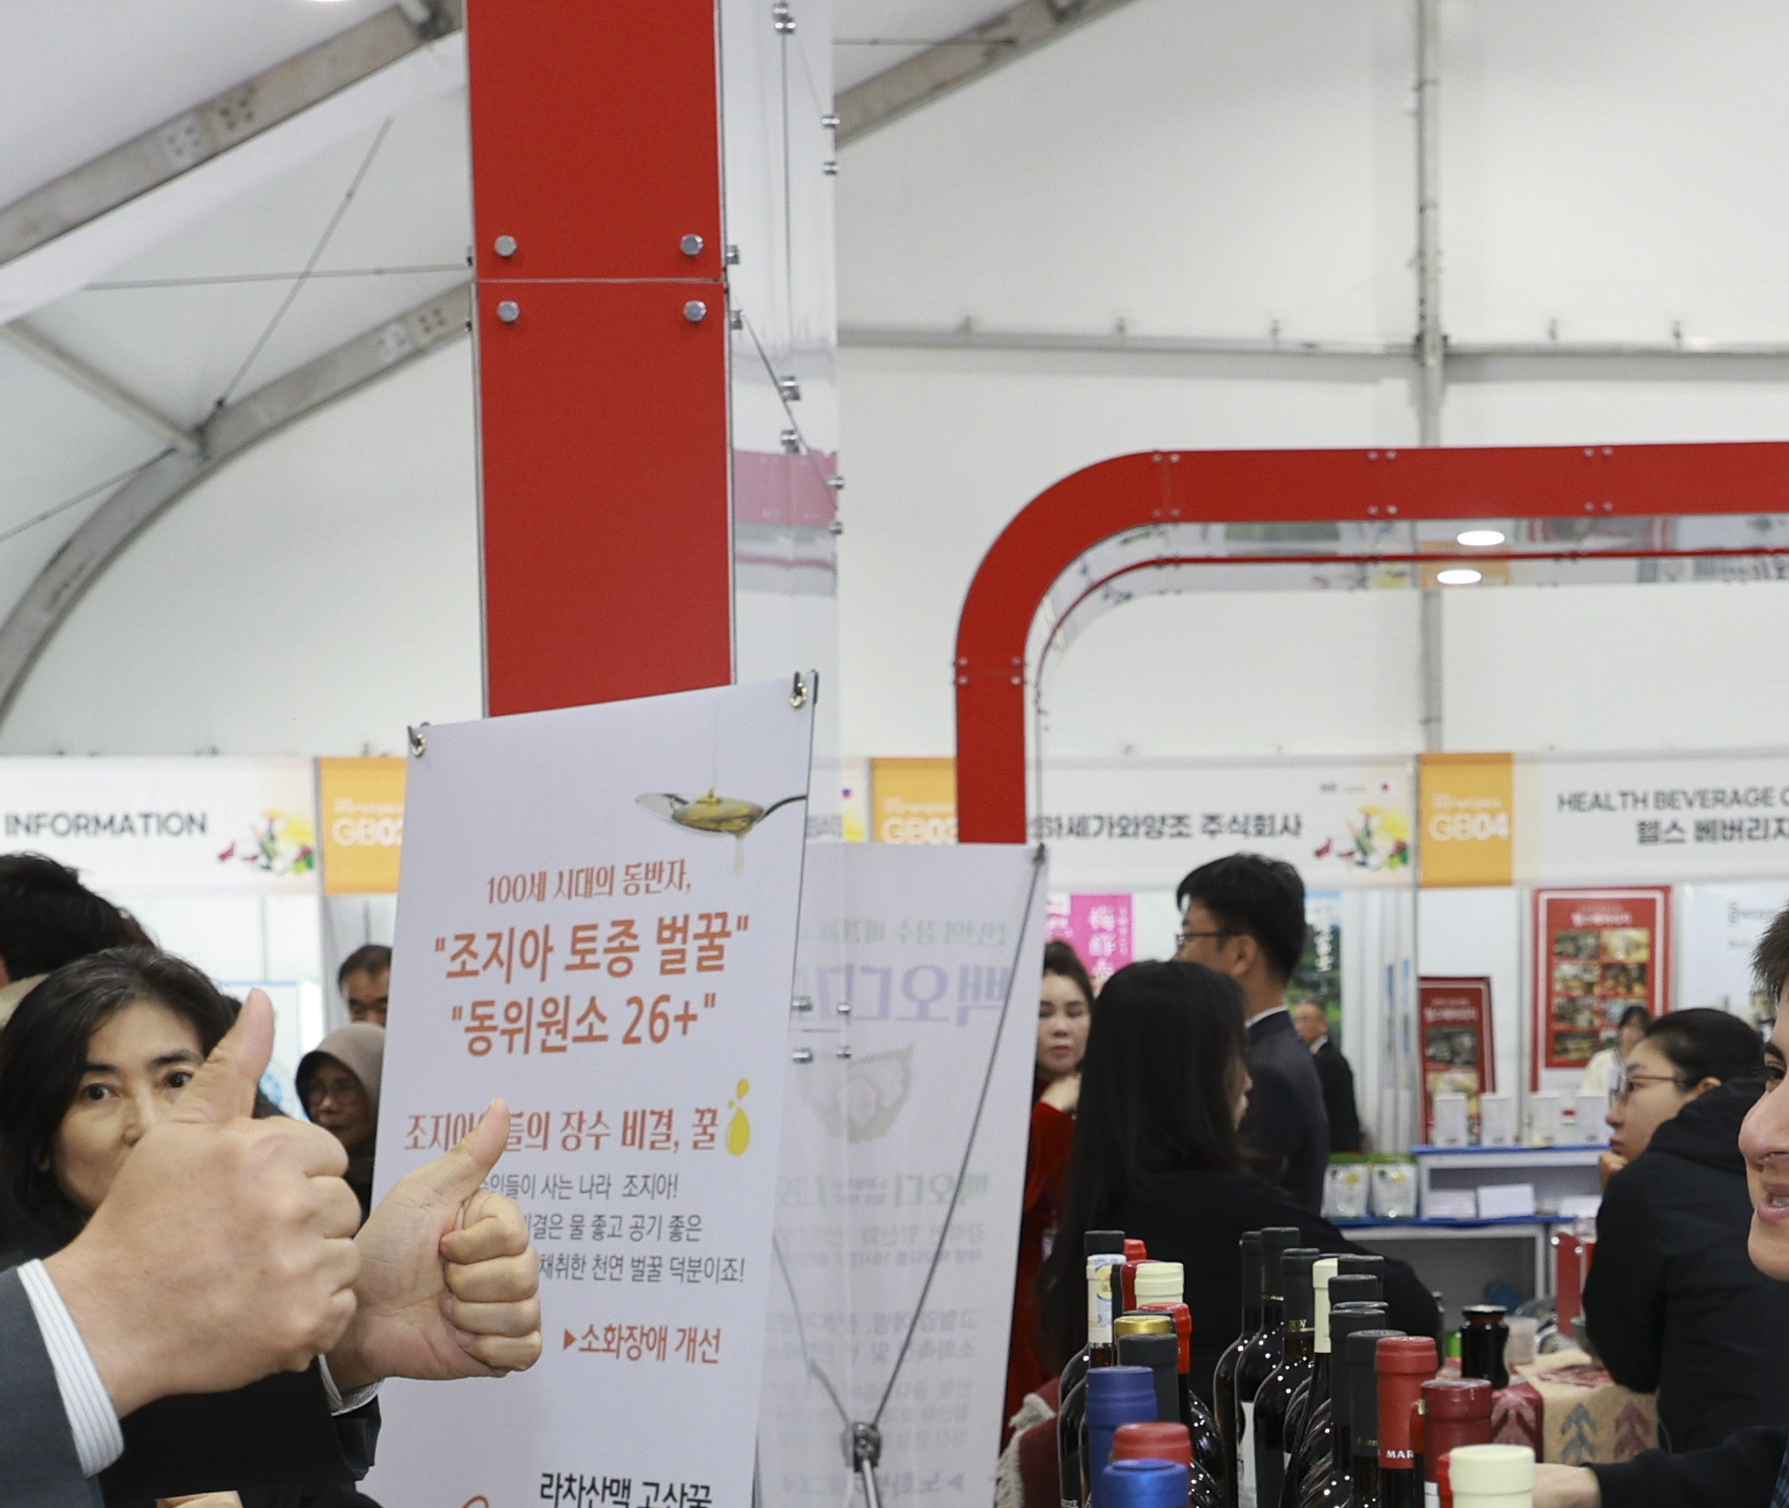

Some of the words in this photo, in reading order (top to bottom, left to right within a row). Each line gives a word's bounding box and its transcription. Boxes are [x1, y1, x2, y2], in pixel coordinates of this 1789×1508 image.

[1557, 790, 1649, 814] HEALTH
[1653, 787, 1777, 812] BEVERAGE
[4, 811, 208, 839] INFORMATION
[1202, 812, 1304, 841] 주식회사
[1428, 812, 1510, 842] GB04
[1636, 818, 1687, 846] 헬스
[486, 871, 547, 905] 100세
[553, 864, 616, 901] 시대의
[622, 858, 693, 897] 동반자,
[434, 923, 555, 985] "조지아
[564, 918, 641, 979] 토종
[655, 911, 750, 977] 벌꿀"
[451, 995, 609, 1057] "동위원소
[621, 992, 718, 1046] 26+"
[403, 1109, 552, 1152] 조지아들의
[559, 1108, 612, 1153] 장수
[620, 1108, 681, 1153] 비결,
[691, 1107, 720, 1152] 꿀
[540, 1173, 575, 1201] 사는
[578, 1173, 613, 1201] 나라
[621, 1173, 679, 1200] 조지아!
[568, 1213, 587, 1241] 물
[590, 1213, 623, 1241] 좋고
[628, 1213, 663, 1242] 공기
[667, 1213, 703, 1242] 좋은
[591, 1253, 624, 1282] 천연
[629, 1253, 664, 1283] 벌꿀
[669, 1253, 746, 1284] 덕분이죠!
[578, 1324, 669, 1363] 소화장애
[674, 1327, 722, 1365] 개선
